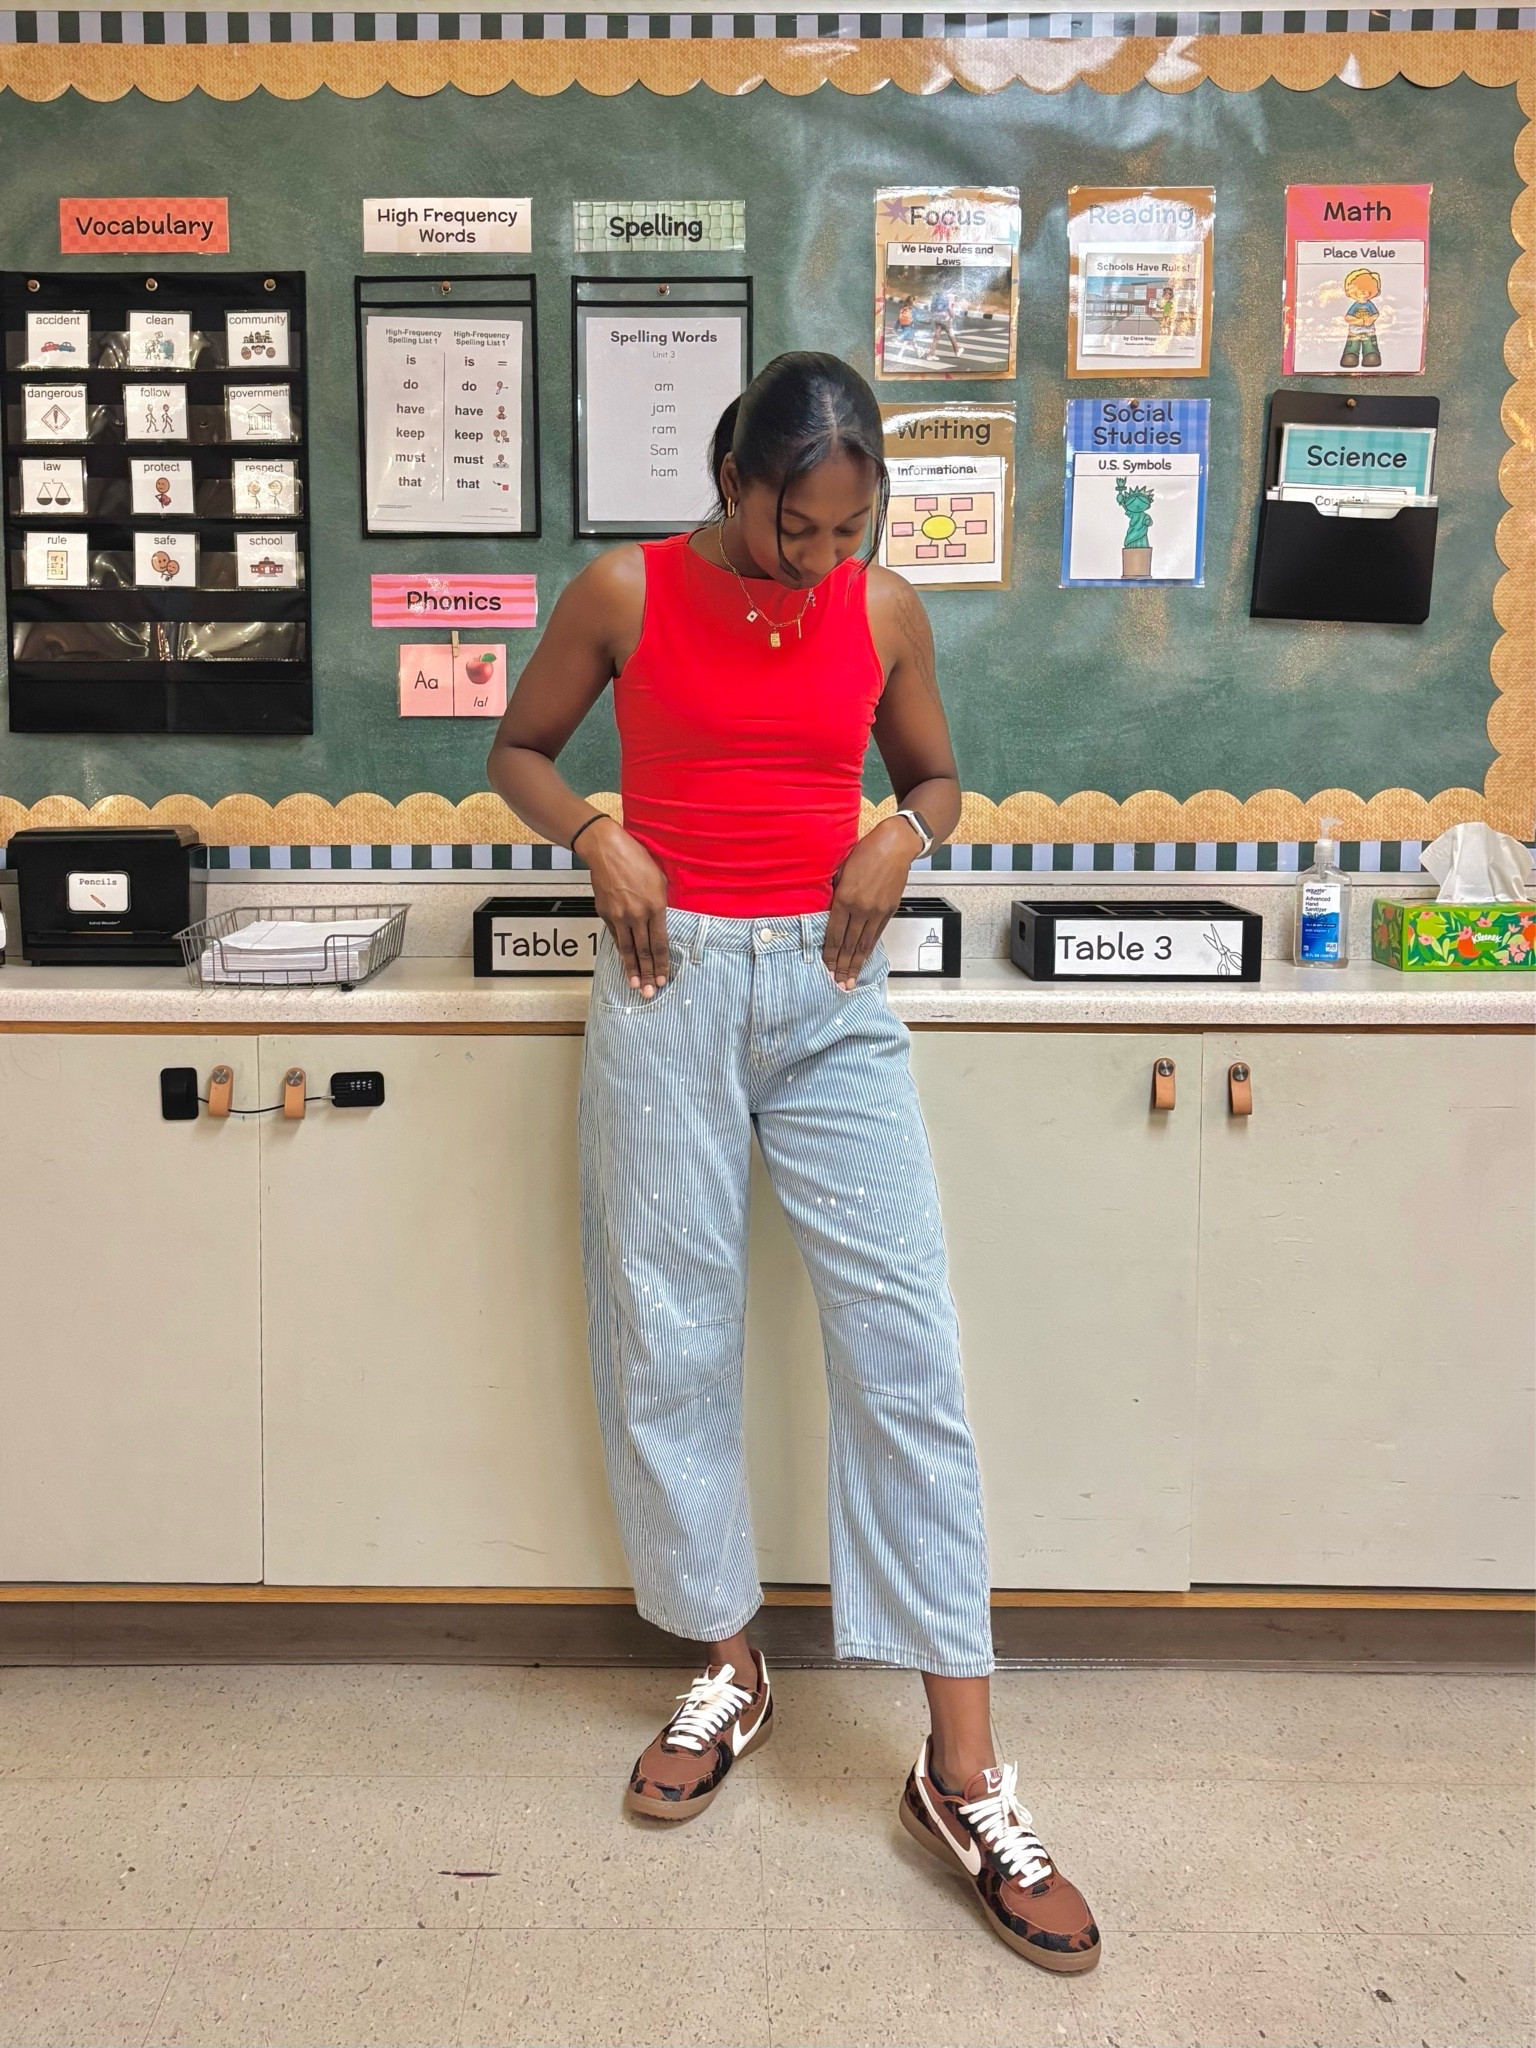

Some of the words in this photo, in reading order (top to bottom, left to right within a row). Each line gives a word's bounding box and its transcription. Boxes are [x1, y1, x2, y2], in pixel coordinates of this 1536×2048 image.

[909, 206, 986, 226] Focus
[1089, 203, 1194, 230] Reading
[1324, 201, 1391, 222] Math
[377, 208, 418, 226] High
[423, 208, 518, 227] Frequency
[75, 213, 214, 241] Vocabulary
[609, 213, 703, 242] Spelling
[419, 229, 476, 242] Words
[902, 244, 916, 253] We
[918, 244, 943, 253] Have
[946, 243, 973, 254] Rules
[975, 245, 994, 254] and
[1323, 247, 1357, 258] Place
[1360, 246, 1395, 258] Value
[936, 257, 961, 266] Laws
[1097, 262, 1134, 271] Schools
[1136, 263, 1159, 271] Have
[35, 315, 80, 325] accident
[145, 315, 174, 325] clean
[229, 314, 286, 327] community
[385, 329, 442, 338] High-Frequency
[454, 331, 510, 340] High-Frequency
[610, 330, 667, 346] Spelling
[672, 330, 717, 343] Words
[388, 336, 417, 345] Spelling
[456, 338, 485, 347] Spelling
[406, 355, 417, 365] is
[652, 351, 668, 359] Unit
[670, 351, 676, 359] 3
[464, 356, 475, 366] is
[403, 379, 419, 389] do
[462, 381, 477, 391] do
[654, 382, 674, 392] am
[27, 388, 83, 400] dangerous
[140, 387, 171, 397] follow
[229, 389, 288, 399] government
[396, 403, 425, 414] have
[455, 405, 484, 416] have
[651, 402, 676, 416] jam
[1103, 401, 1174, 423] Social
[396, 427, 425, 440] keep
[455, 429, 484, 442] keep
[652, 425, 677, 435] ram
[898, 420, 991, 445] Writing
[1093, 426, 1182, 445] Studies
[650, 444, 678, 456] Sam
[395, 453, 426, 463] must
[454, 455, 484, 465] must
[1307, 445, 1407, 468] Science
[43, 461, 61, 471] law
[143, 462, 180, 474] protect
[245, 463, 284, 474] respect
[651, 465, 678, 477] ham
[898, 464, 978, 476] Informational
[1098, 460, 1120, 470] U.S.
[1123, 459, 1172, 473] Symbols
[398, 477, 422, 487] that
[457, 479, 480, 489] that
[47, 535, 67, 545] rule
[154, 535, 176, 545] safe
[249, 536, 283, 546] school
[407, 591, 501, 611] Phonics
[414, 670, 439, 690] Aa
[79, 878, 117, 886] Pencils
[494, 928, 578, 957] Table
[588, 932, 598, 956] 1
[1471, 932, 1502, 944] Kleenex
[1057, 931, 1144, 961] Table
[1154, 935, 1172, 960] 3
